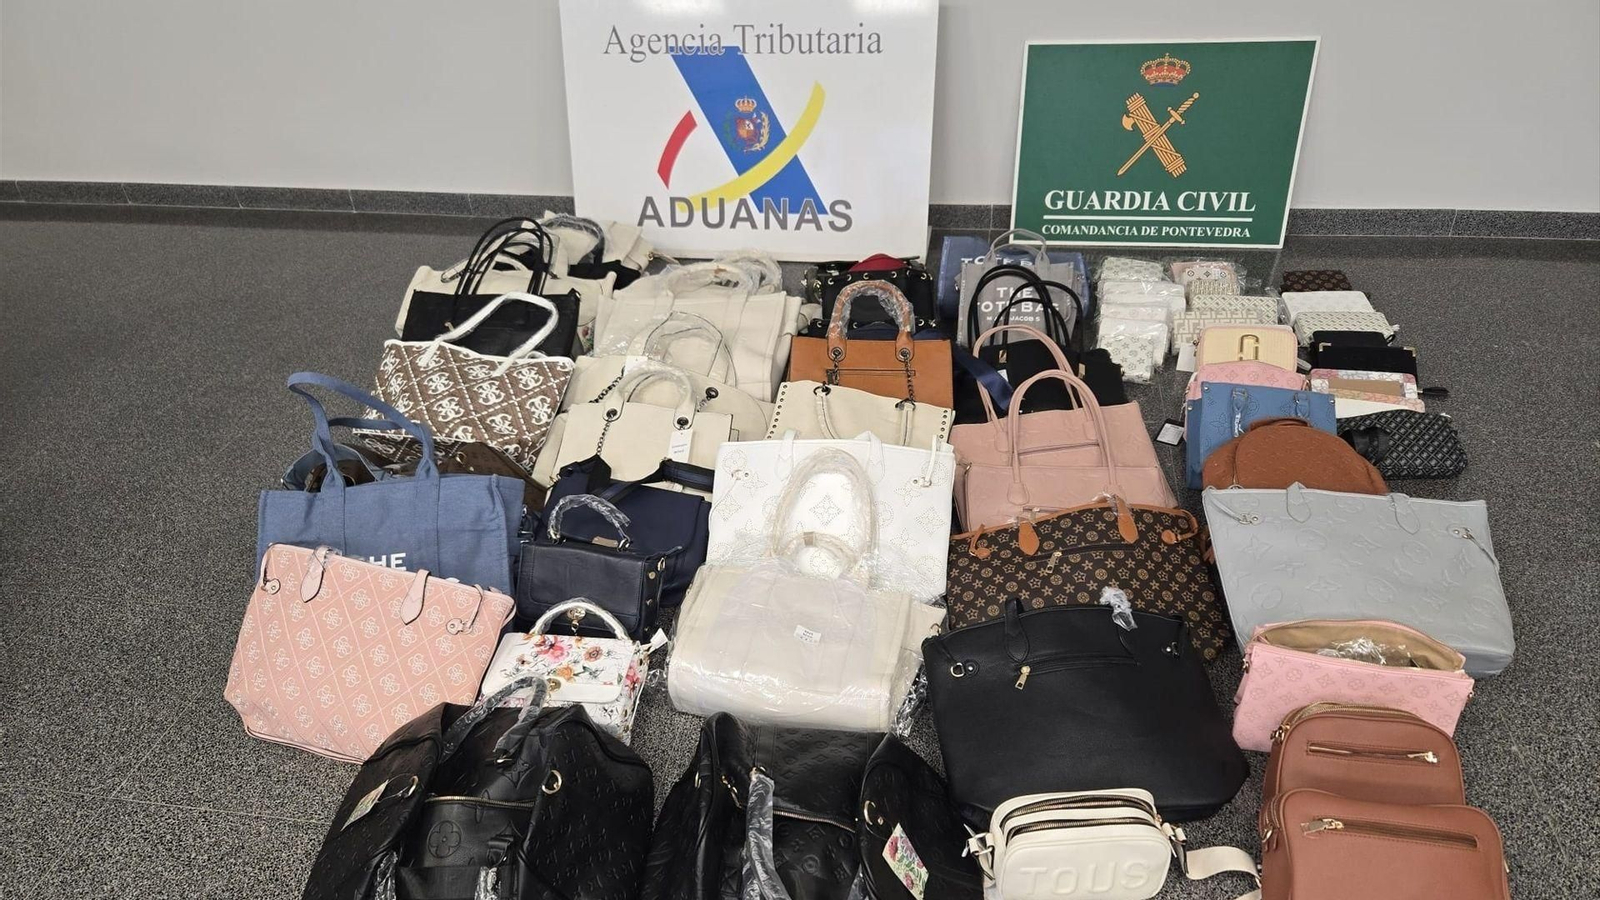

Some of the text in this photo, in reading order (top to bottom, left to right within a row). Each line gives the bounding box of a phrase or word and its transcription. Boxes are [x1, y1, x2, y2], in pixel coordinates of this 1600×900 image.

[603, 23, 884, 63] Agencia Tributaria
[637, 196, 854, 233] ADUANAS
[1044, 190, 1257, 212] GUARDIA CIVIL
[1041, 224, 1251, 238] COMANDANCIA DE PONTEVEDRA
[1019, 859, 1149, 896] TOUS
